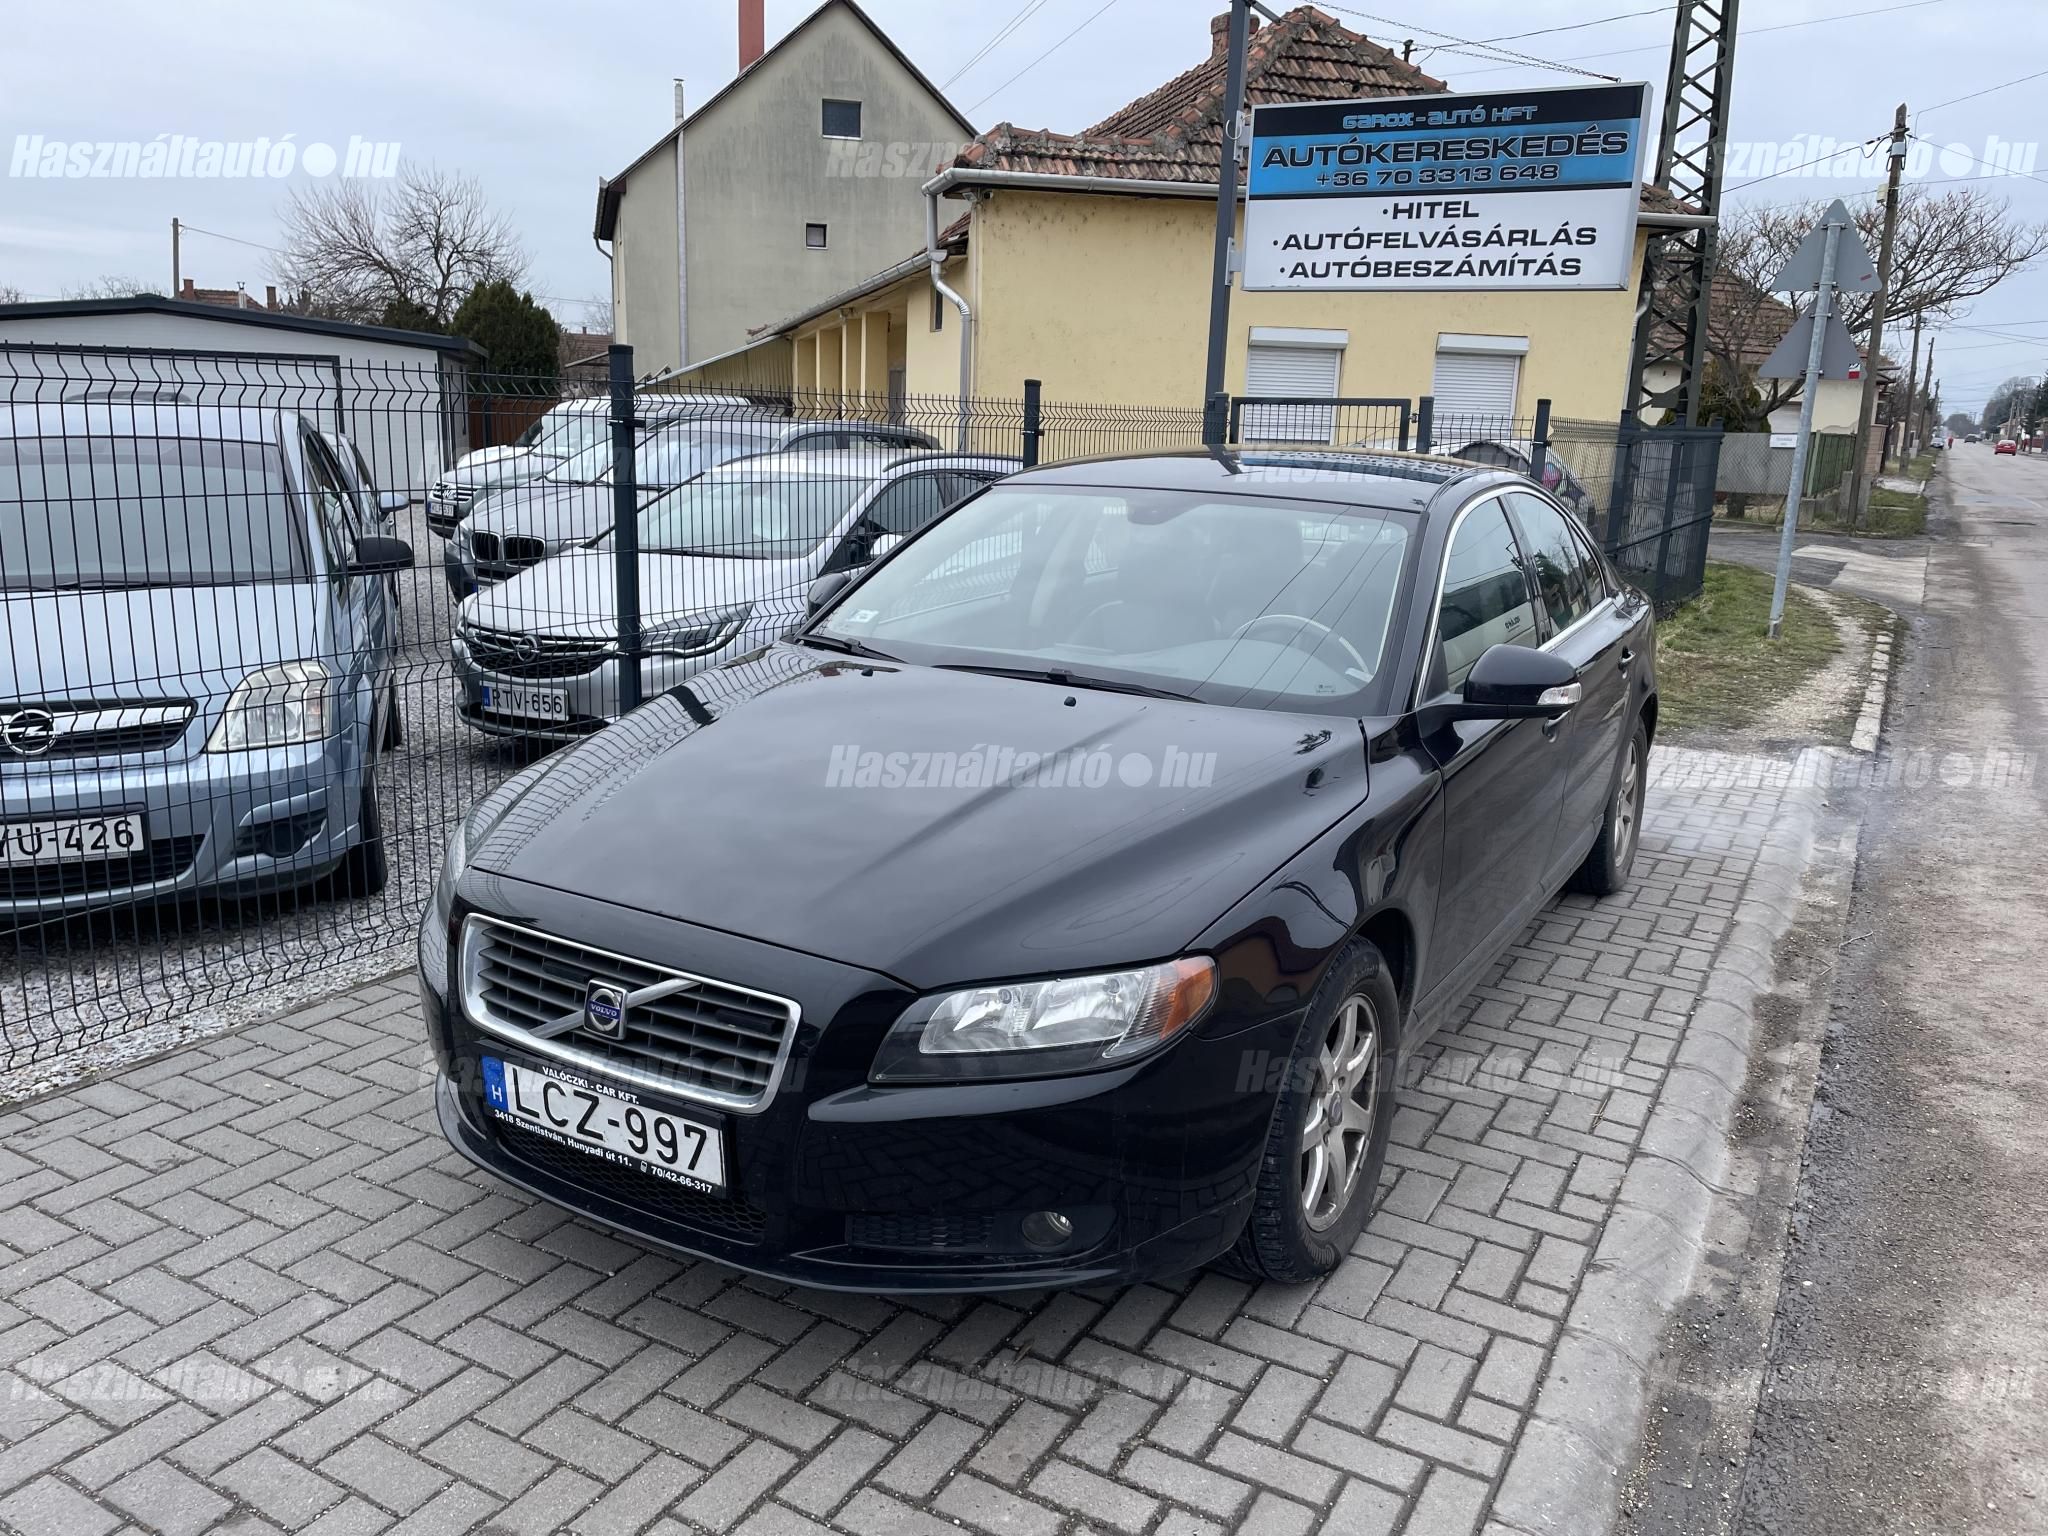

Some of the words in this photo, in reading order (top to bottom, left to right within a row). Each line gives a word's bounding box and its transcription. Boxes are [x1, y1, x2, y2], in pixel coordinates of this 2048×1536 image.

[1262, 124, 1629, 168] AUTÓKERESKEDÉS
[1316, 170, 1369, 187] +36
[1376, 169, 1413, 186] 70
[1418, 166, 1492, 184] 3313
[1499, 164, 1559, 181] 648
[1392, 200, 1480, 219] HITEL
[1281, 221, 1597, 250] AUTÓFELVÁSÁRLÁS
[1288, 251, 1581, 278] AUTÓBESZÁMÍTÁS
[492, 689, 563, 713] RTV-656
[591, 1004, 618, 1017] VOLVO
[541, 1066, 588, 1089] VALÓCZKI
[596, 1083, 616, 1098] CAR
[618, 1089, 639, 1104] KFT.
[512, 1067, 708, 1171] LCZ-997
[494, 1109, 514, 1124] 3418
[515, 1116, 566, 1146] Szentistván,
[567, 1137, 603, 1159] Hunyadi
[605, 1150, 616, 1161] út
[651, 1166, 713, 1194] 70/42-66-317
